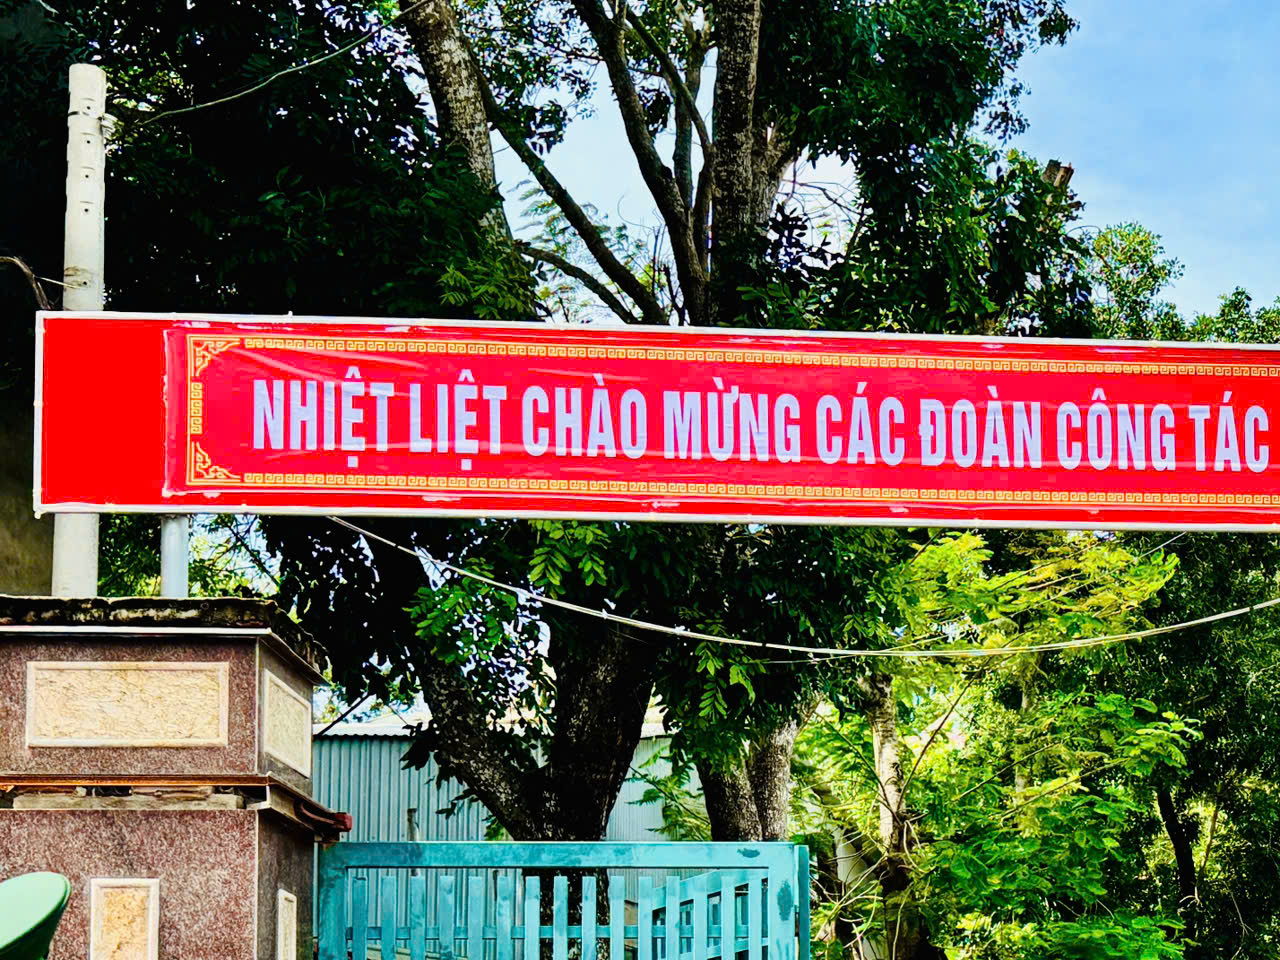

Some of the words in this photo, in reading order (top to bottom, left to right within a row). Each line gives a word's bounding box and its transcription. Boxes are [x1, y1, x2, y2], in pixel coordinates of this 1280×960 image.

[252, 364, 395, 471] NHIỆT
[409, 369, 508, 473] LIỆT
[521, 373, 648, 460] CHÀO
[662, 376, 803, 464] MỪNG
[817, 380, 906, 467] CÁC
[918, 385, 1043, 470] ĐOÀN
[1057, 387, 1177, 471] CÔNG
[1187, 391, 1270, 473] TÁC
